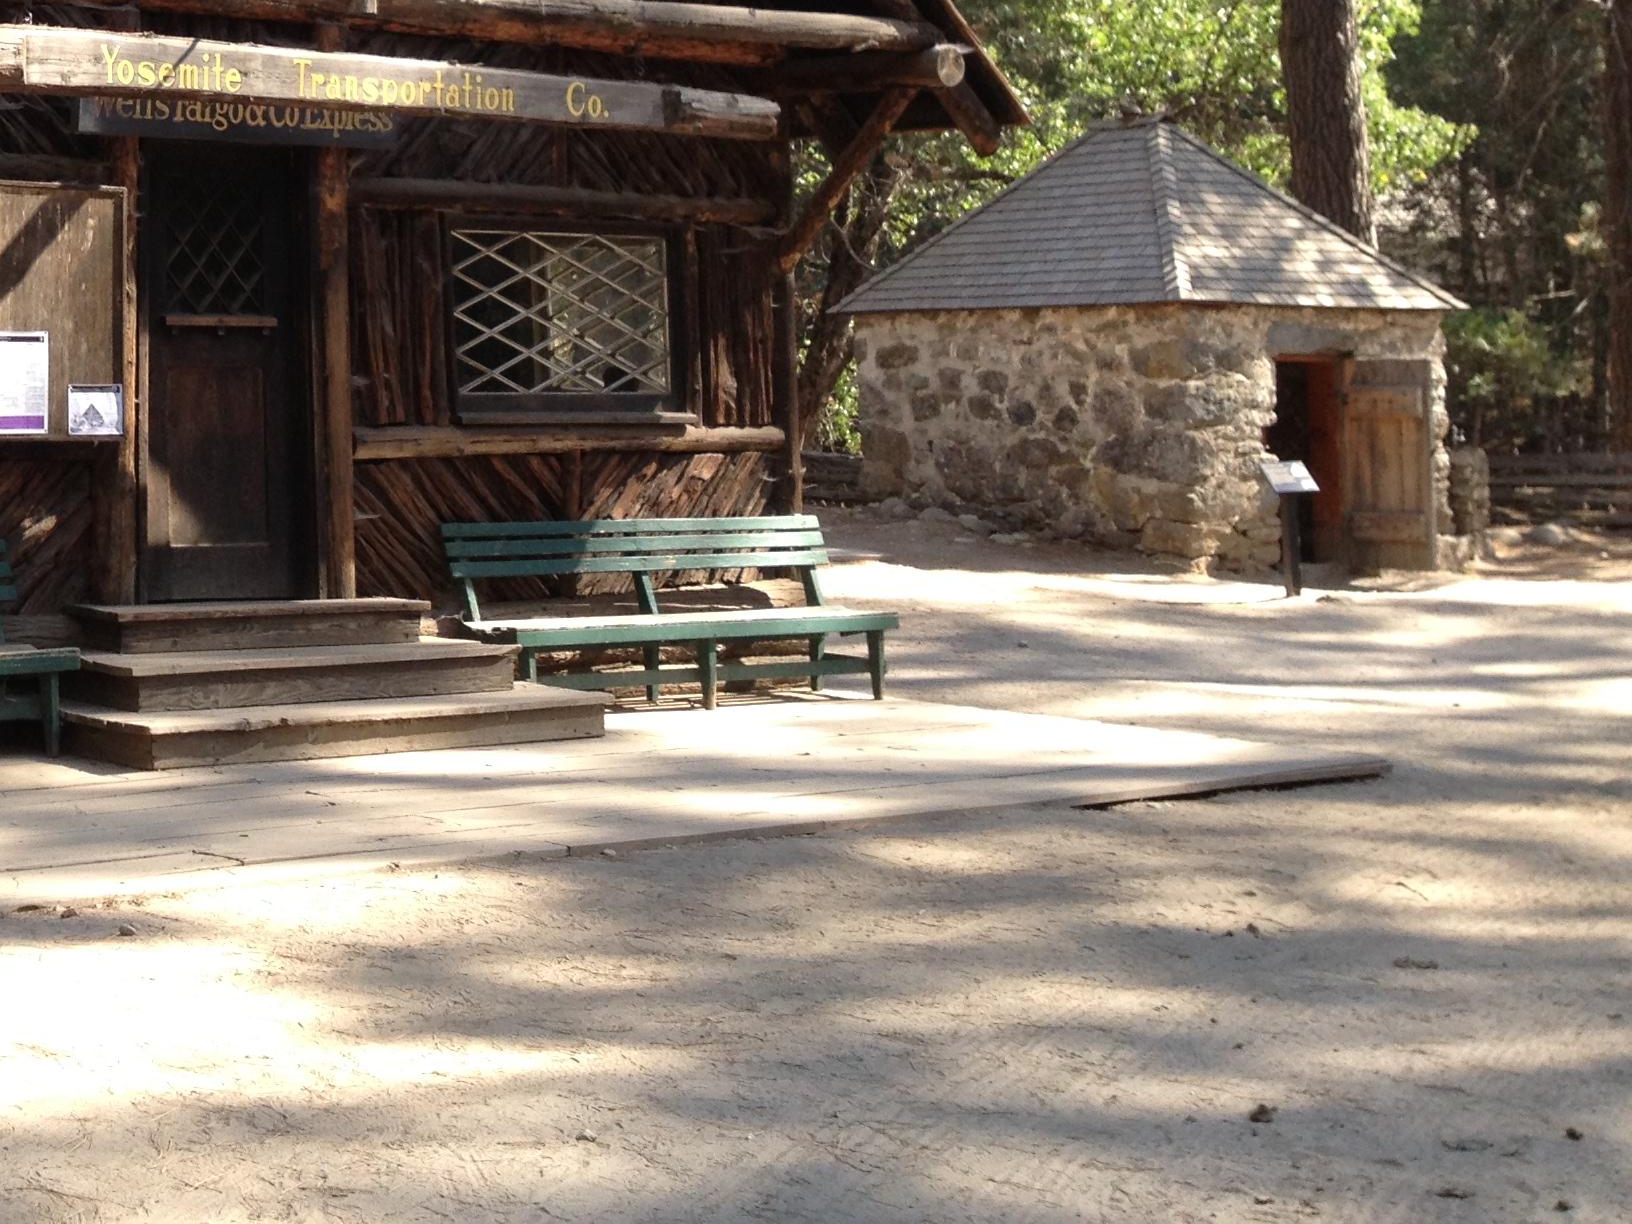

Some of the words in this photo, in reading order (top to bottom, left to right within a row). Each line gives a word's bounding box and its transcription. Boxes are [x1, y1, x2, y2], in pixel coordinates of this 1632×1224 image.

[100, 42, 242, 92] Yosemite
[293, 58, 515, 112] Transportation
[566, 81, 610, 119] Co.
